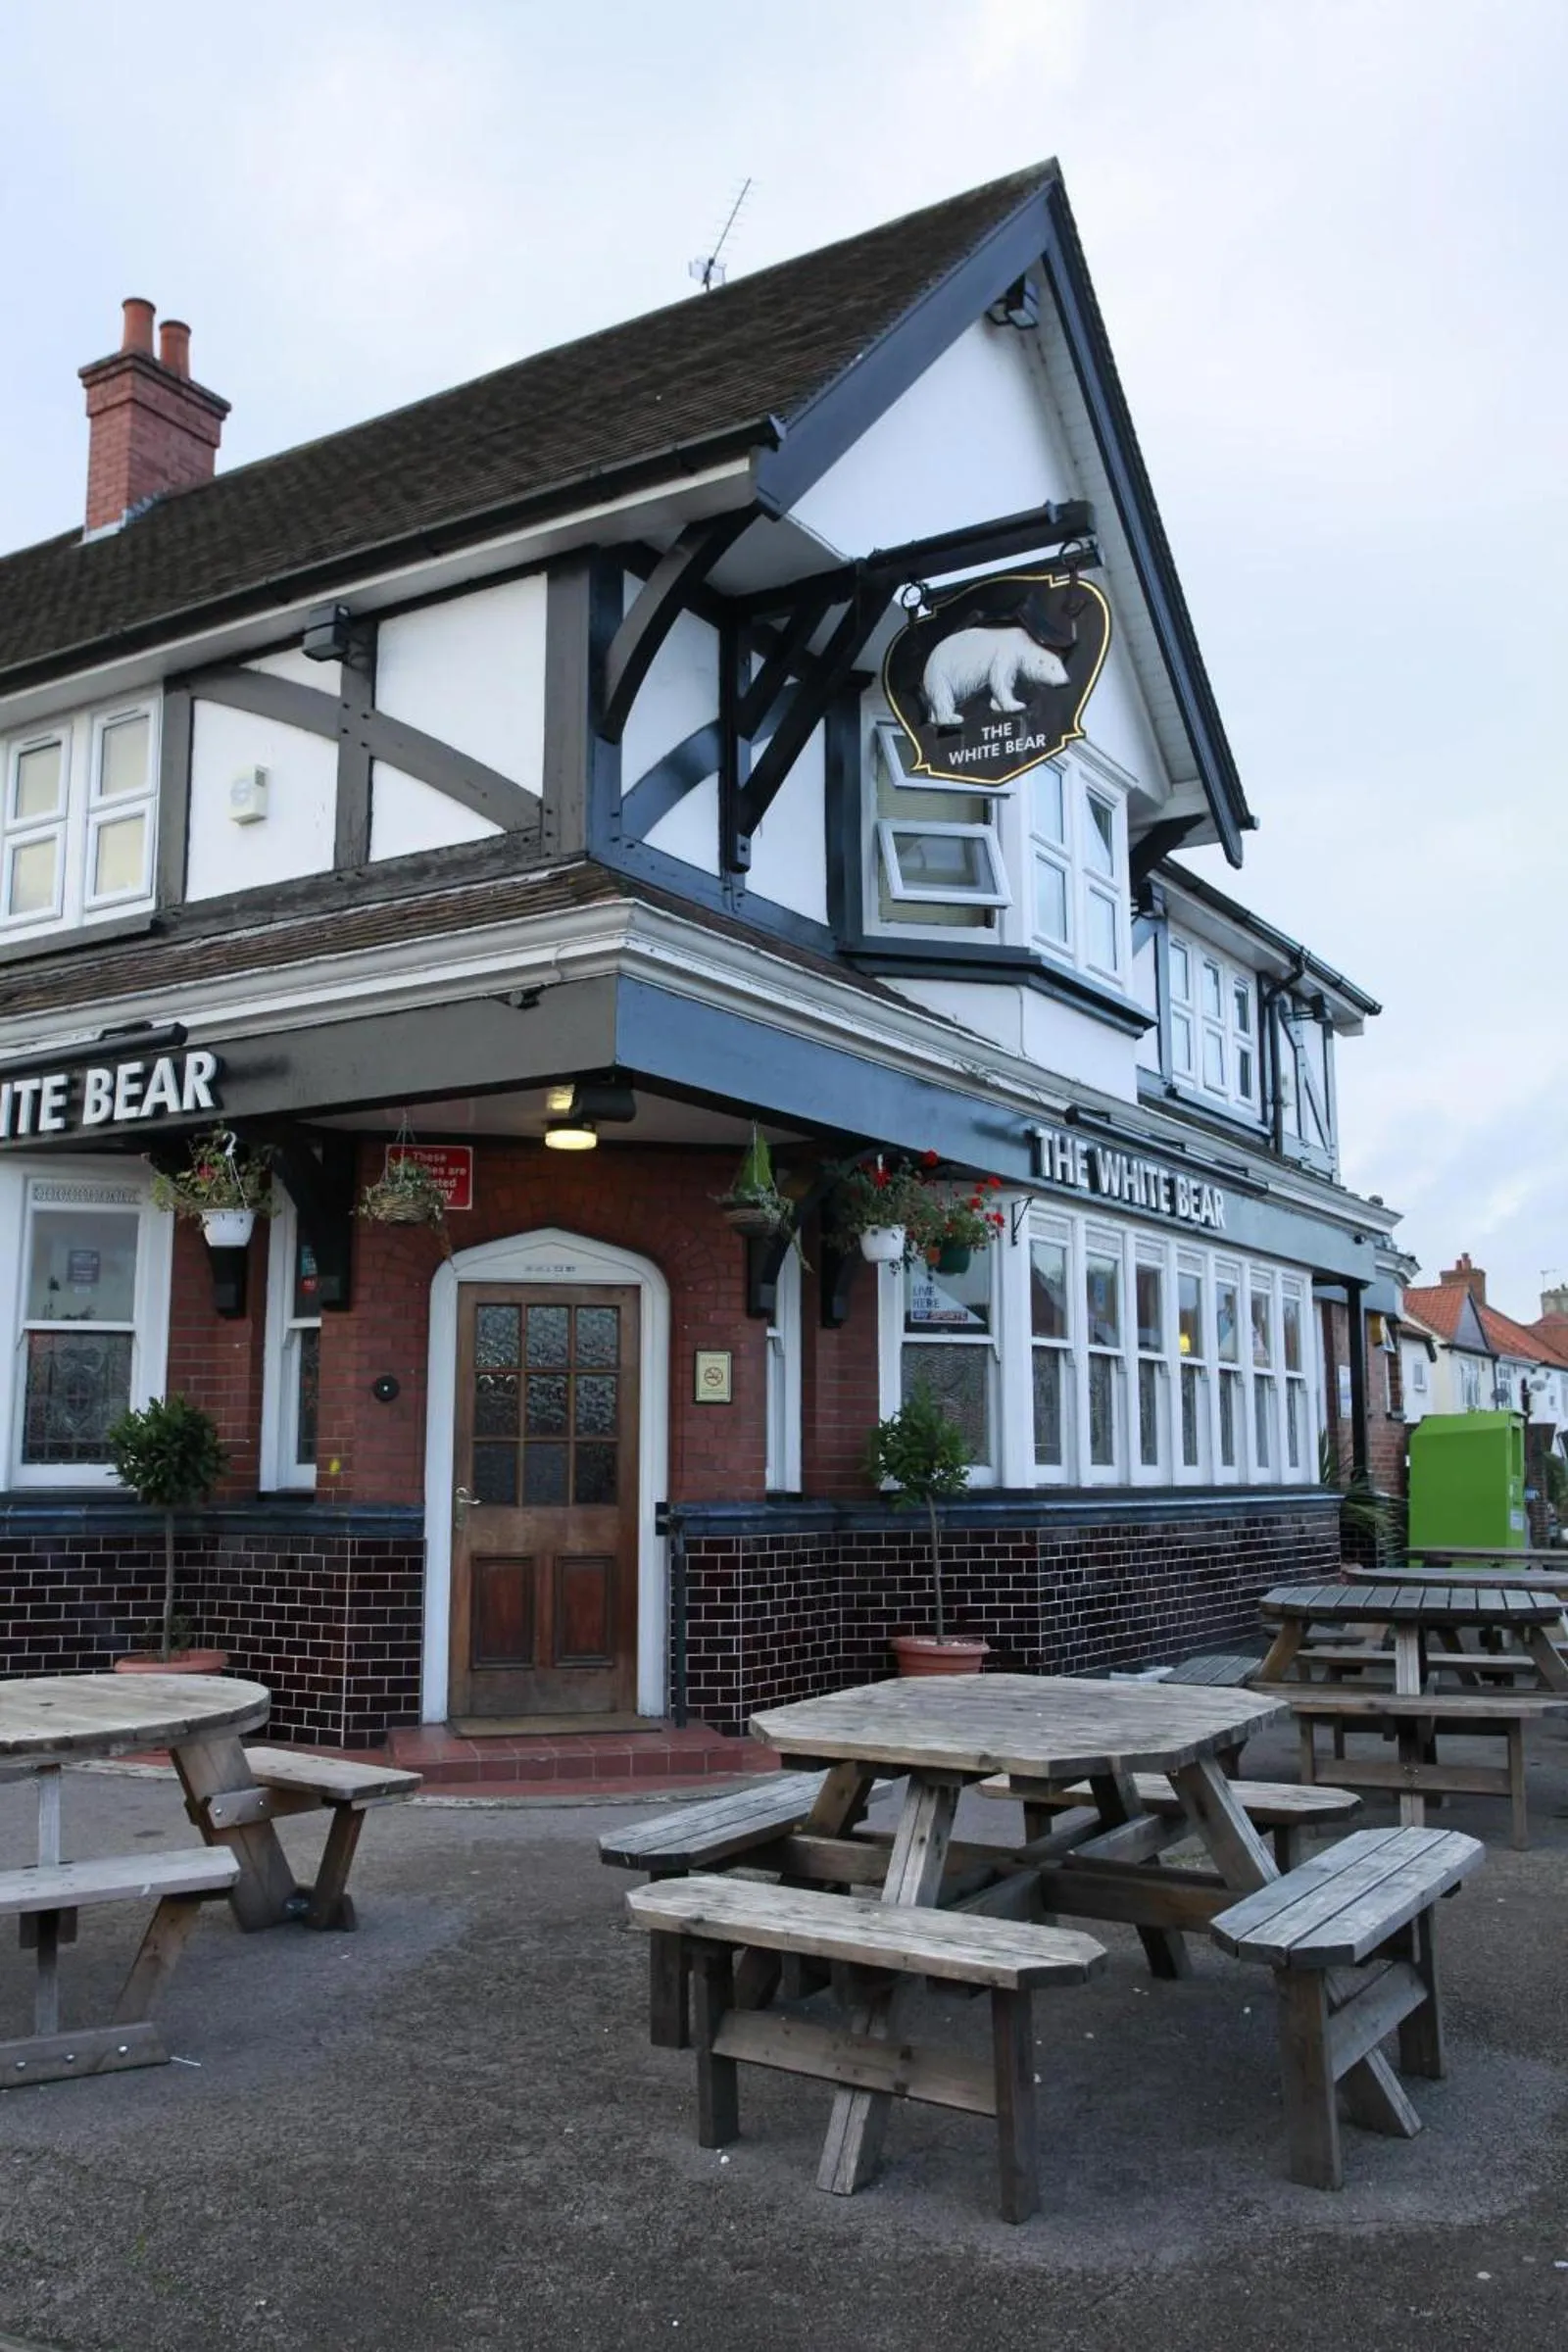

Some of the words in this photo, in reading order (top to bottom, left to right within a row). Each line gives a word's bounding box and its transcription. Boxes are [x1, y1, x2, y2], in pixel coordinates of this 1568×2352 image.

[981, 722, 1012, 741] THE
[949, 743, 1000, 765] WHITE
[1004, 733, 1047, 755] BEAR
[82, 1051, 219, 1126] BEAR
[413, 1152, 448, 1162] These
[1036, 1127, 1089, 1188] THE
[1096, 1146, 1171, 1213] WHITE
[1177, 1173, 1226, 1230] BEAR
